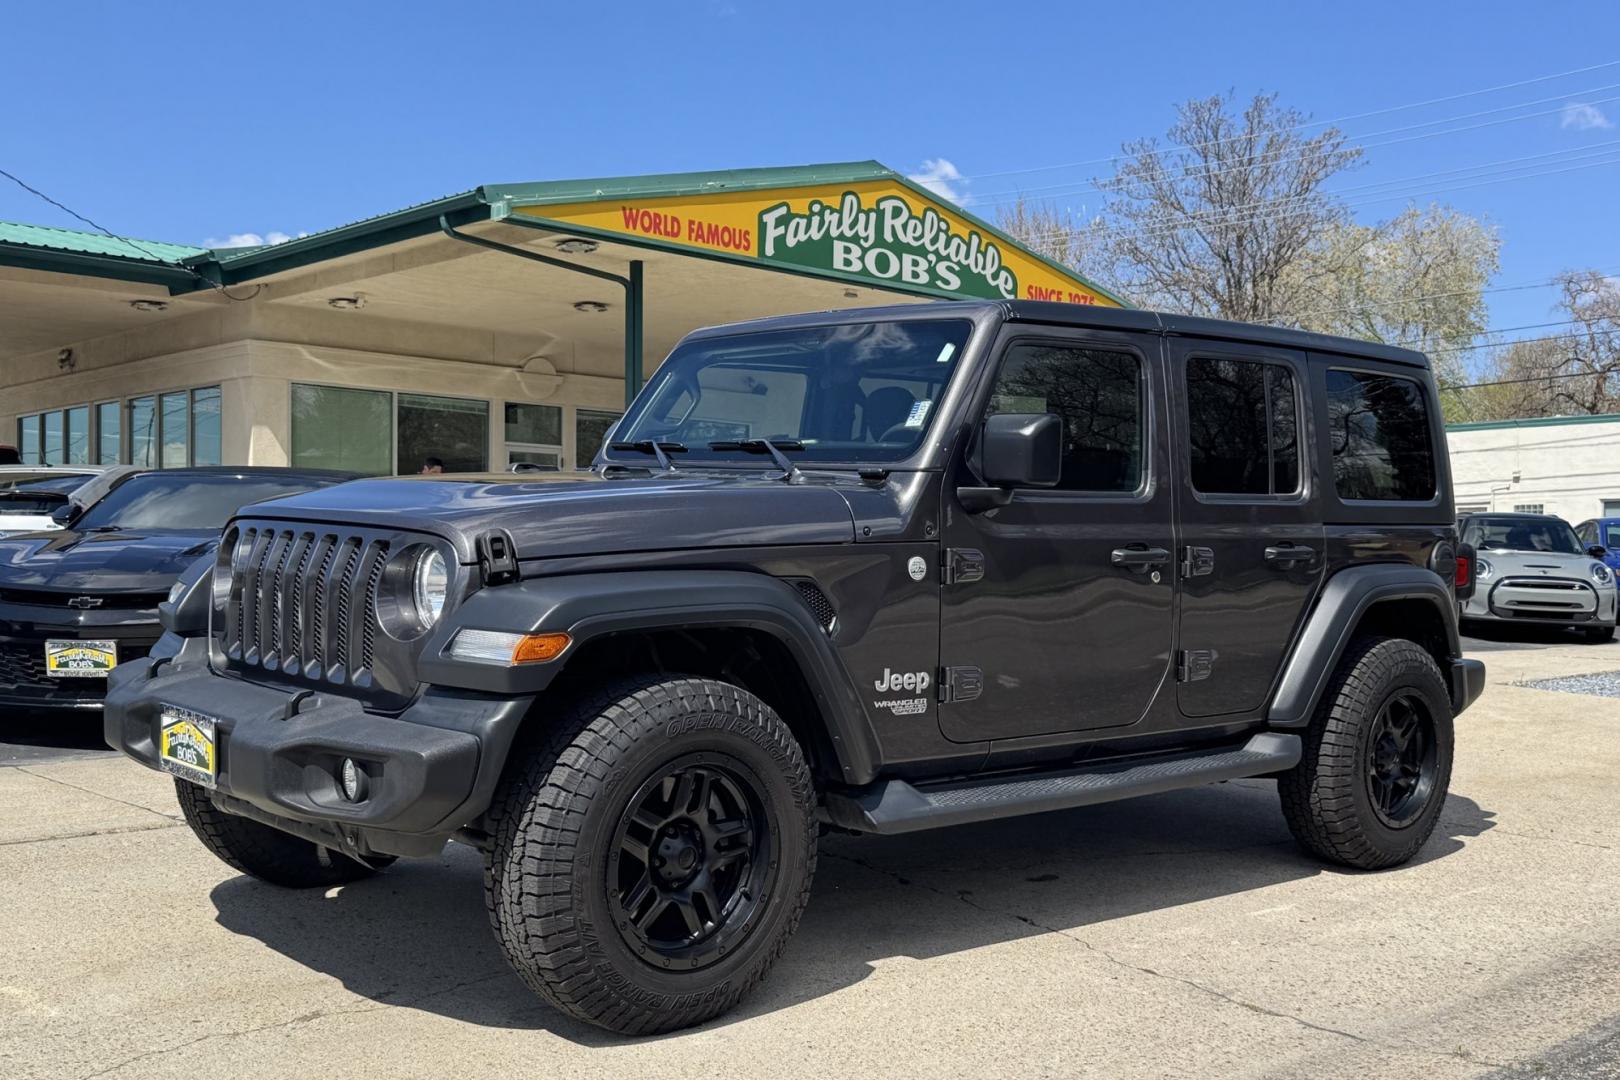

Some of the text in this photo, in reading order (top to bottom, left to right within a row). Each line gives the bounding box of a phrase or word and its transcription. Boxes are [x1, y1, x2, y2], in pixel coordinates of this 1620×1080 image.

[621, 206, 751, 252] WORLD FAMOUS
[762, 194, 1015, 300] Fairly Reliable
[832, 240, 962, 291] BOB'S
[875, 668, 930, 694] Jeep
[873, 698, 927, 708] WRANGLER
[666, 712, 728, 737] OPEN
